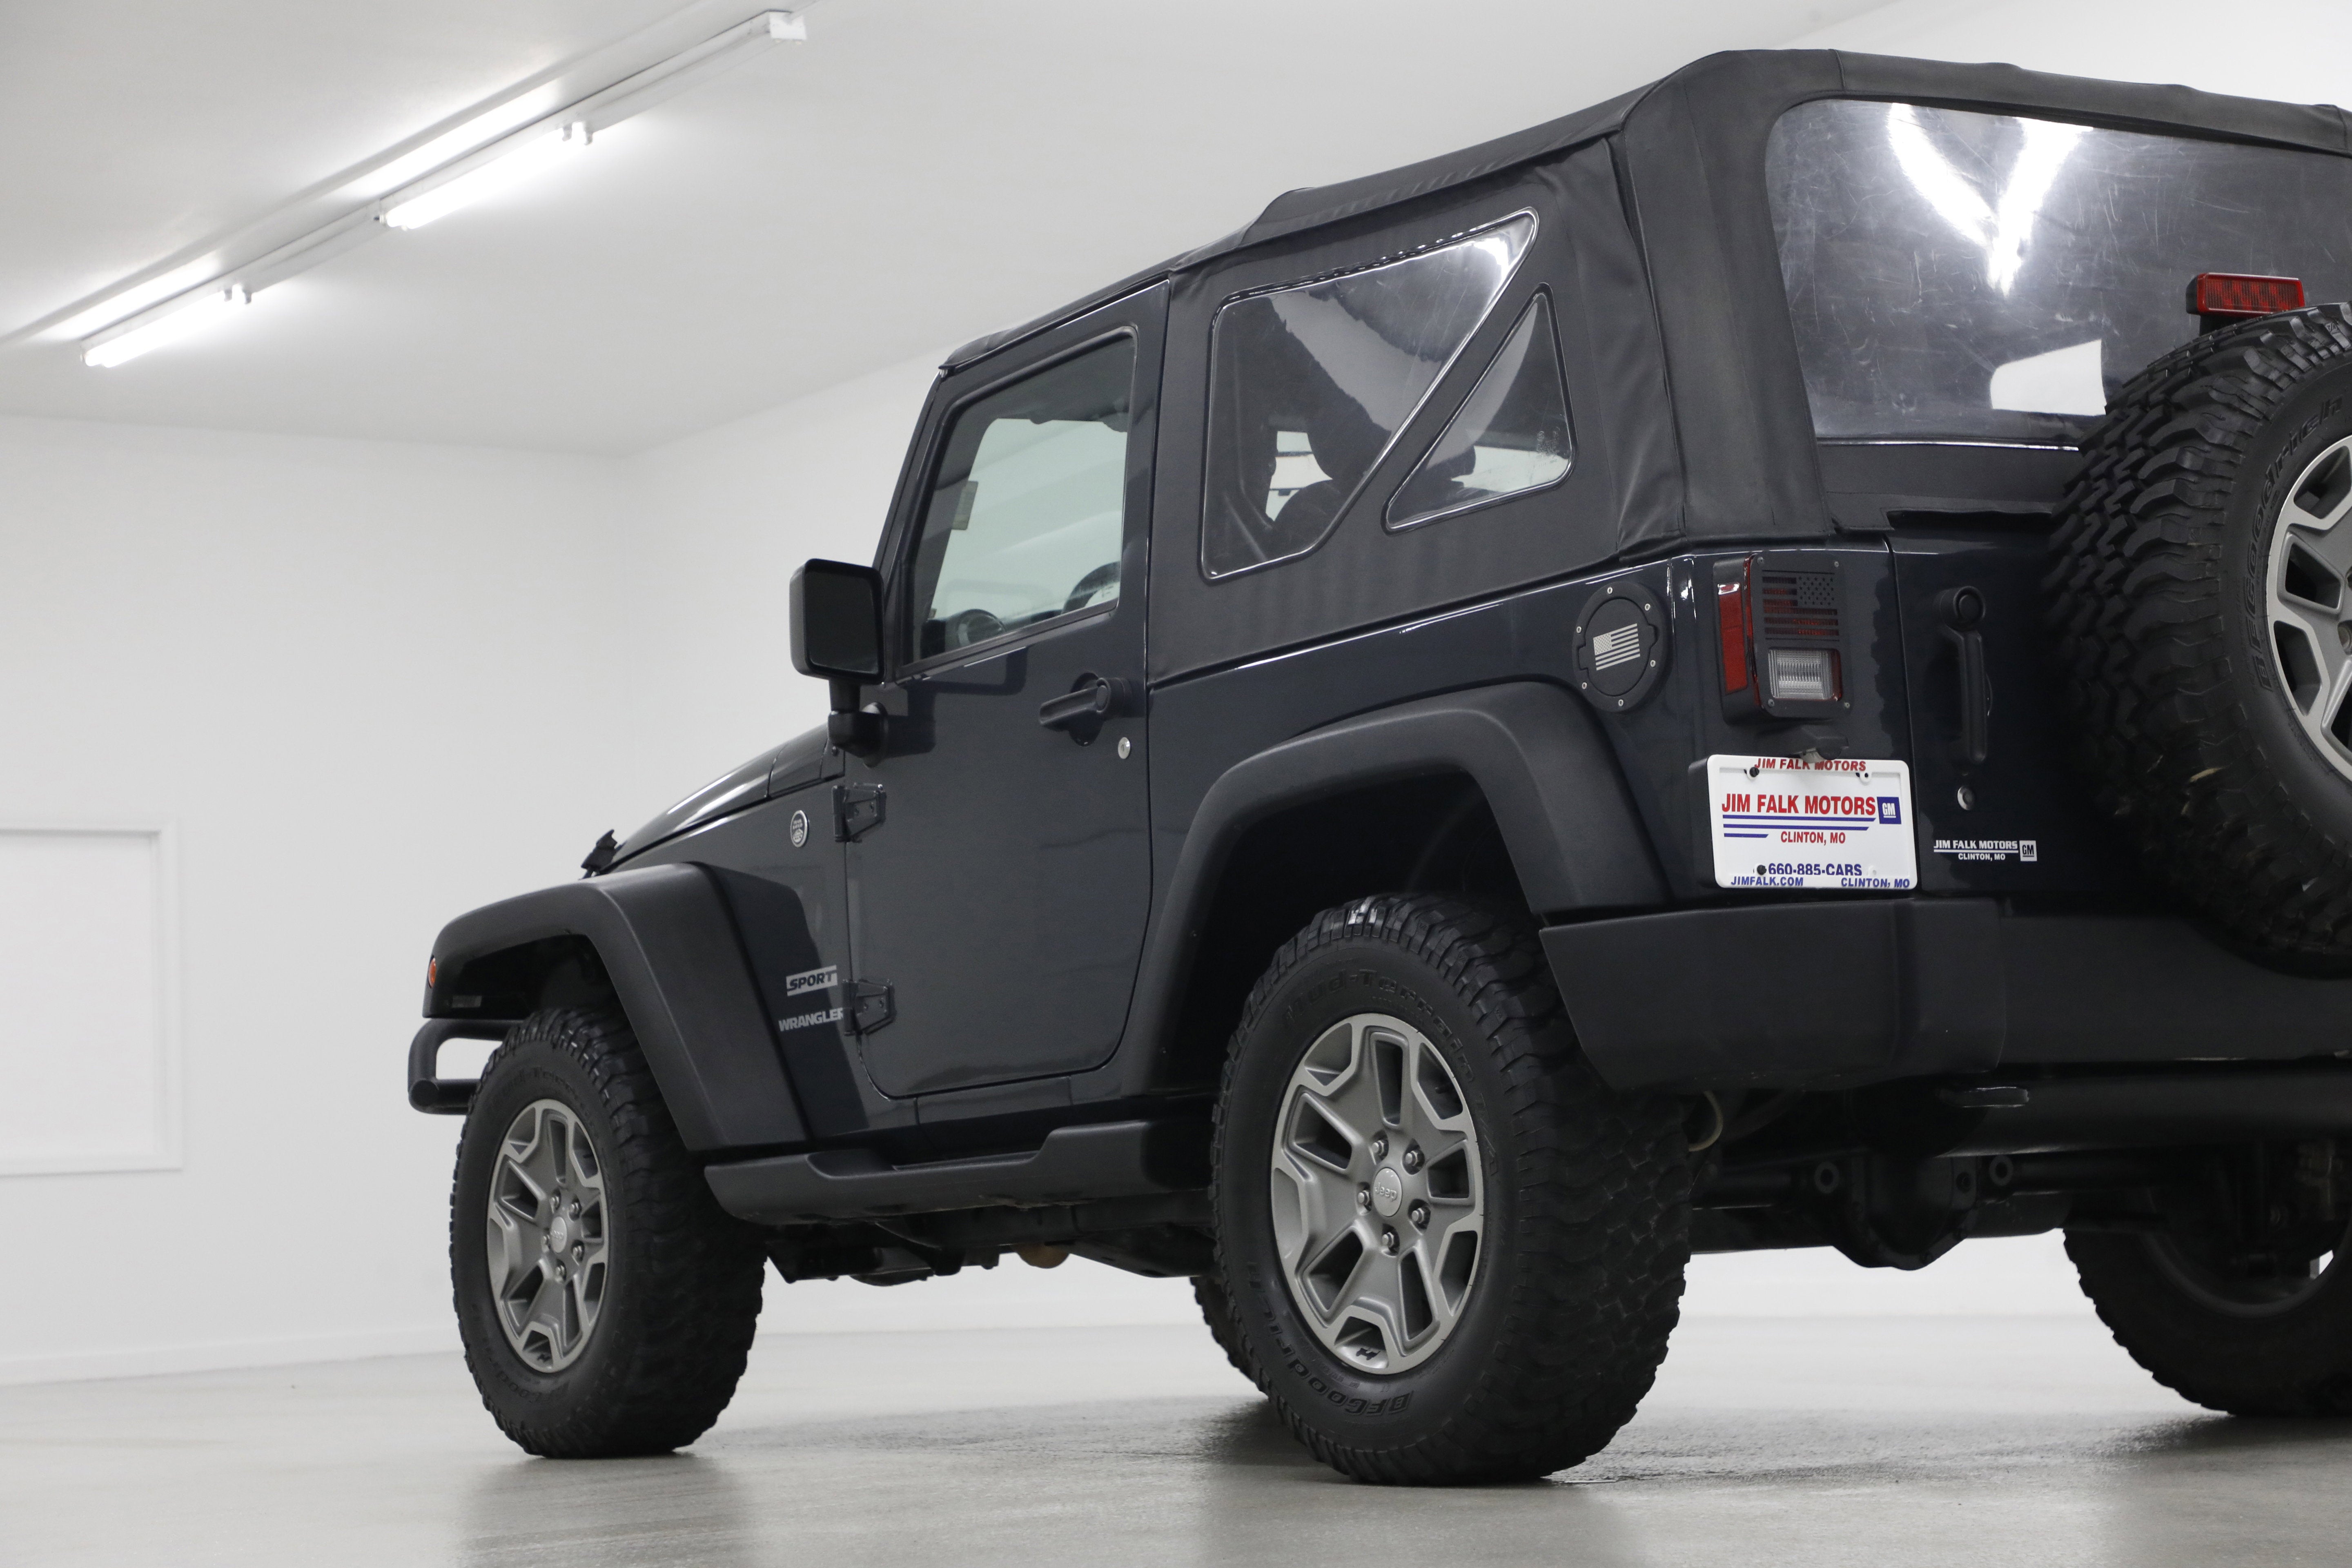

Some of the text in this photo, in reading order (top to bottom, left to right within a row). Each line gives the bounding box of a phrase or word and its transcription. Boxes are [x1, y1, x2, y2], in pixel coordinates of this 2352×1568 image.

[1754, 758, 1866, 771] JIM FALK MOTORS
[1722, 793, 1876, 815] JIM FALK MOTORS
[1882, 802, 1896, 816] GM
[1780, 831, 1846, 846] CLINTON, MO
[1933, 840, 2018, 849] JIM FALK MOTORS
[2022, 844, 2035, 855] GM
[1958, 853, 1993, 862] CLINTON,
[1768, 863, 1862, 876] 660-885-CARS
[1731, 876, 1804, 886] JIMFALK.COM
[1841, 878, 1910, 888] CLINTON, MO
[787, 969, 837, 991] SPORT
[1374, 1182, 1397, 1203] Jeep
